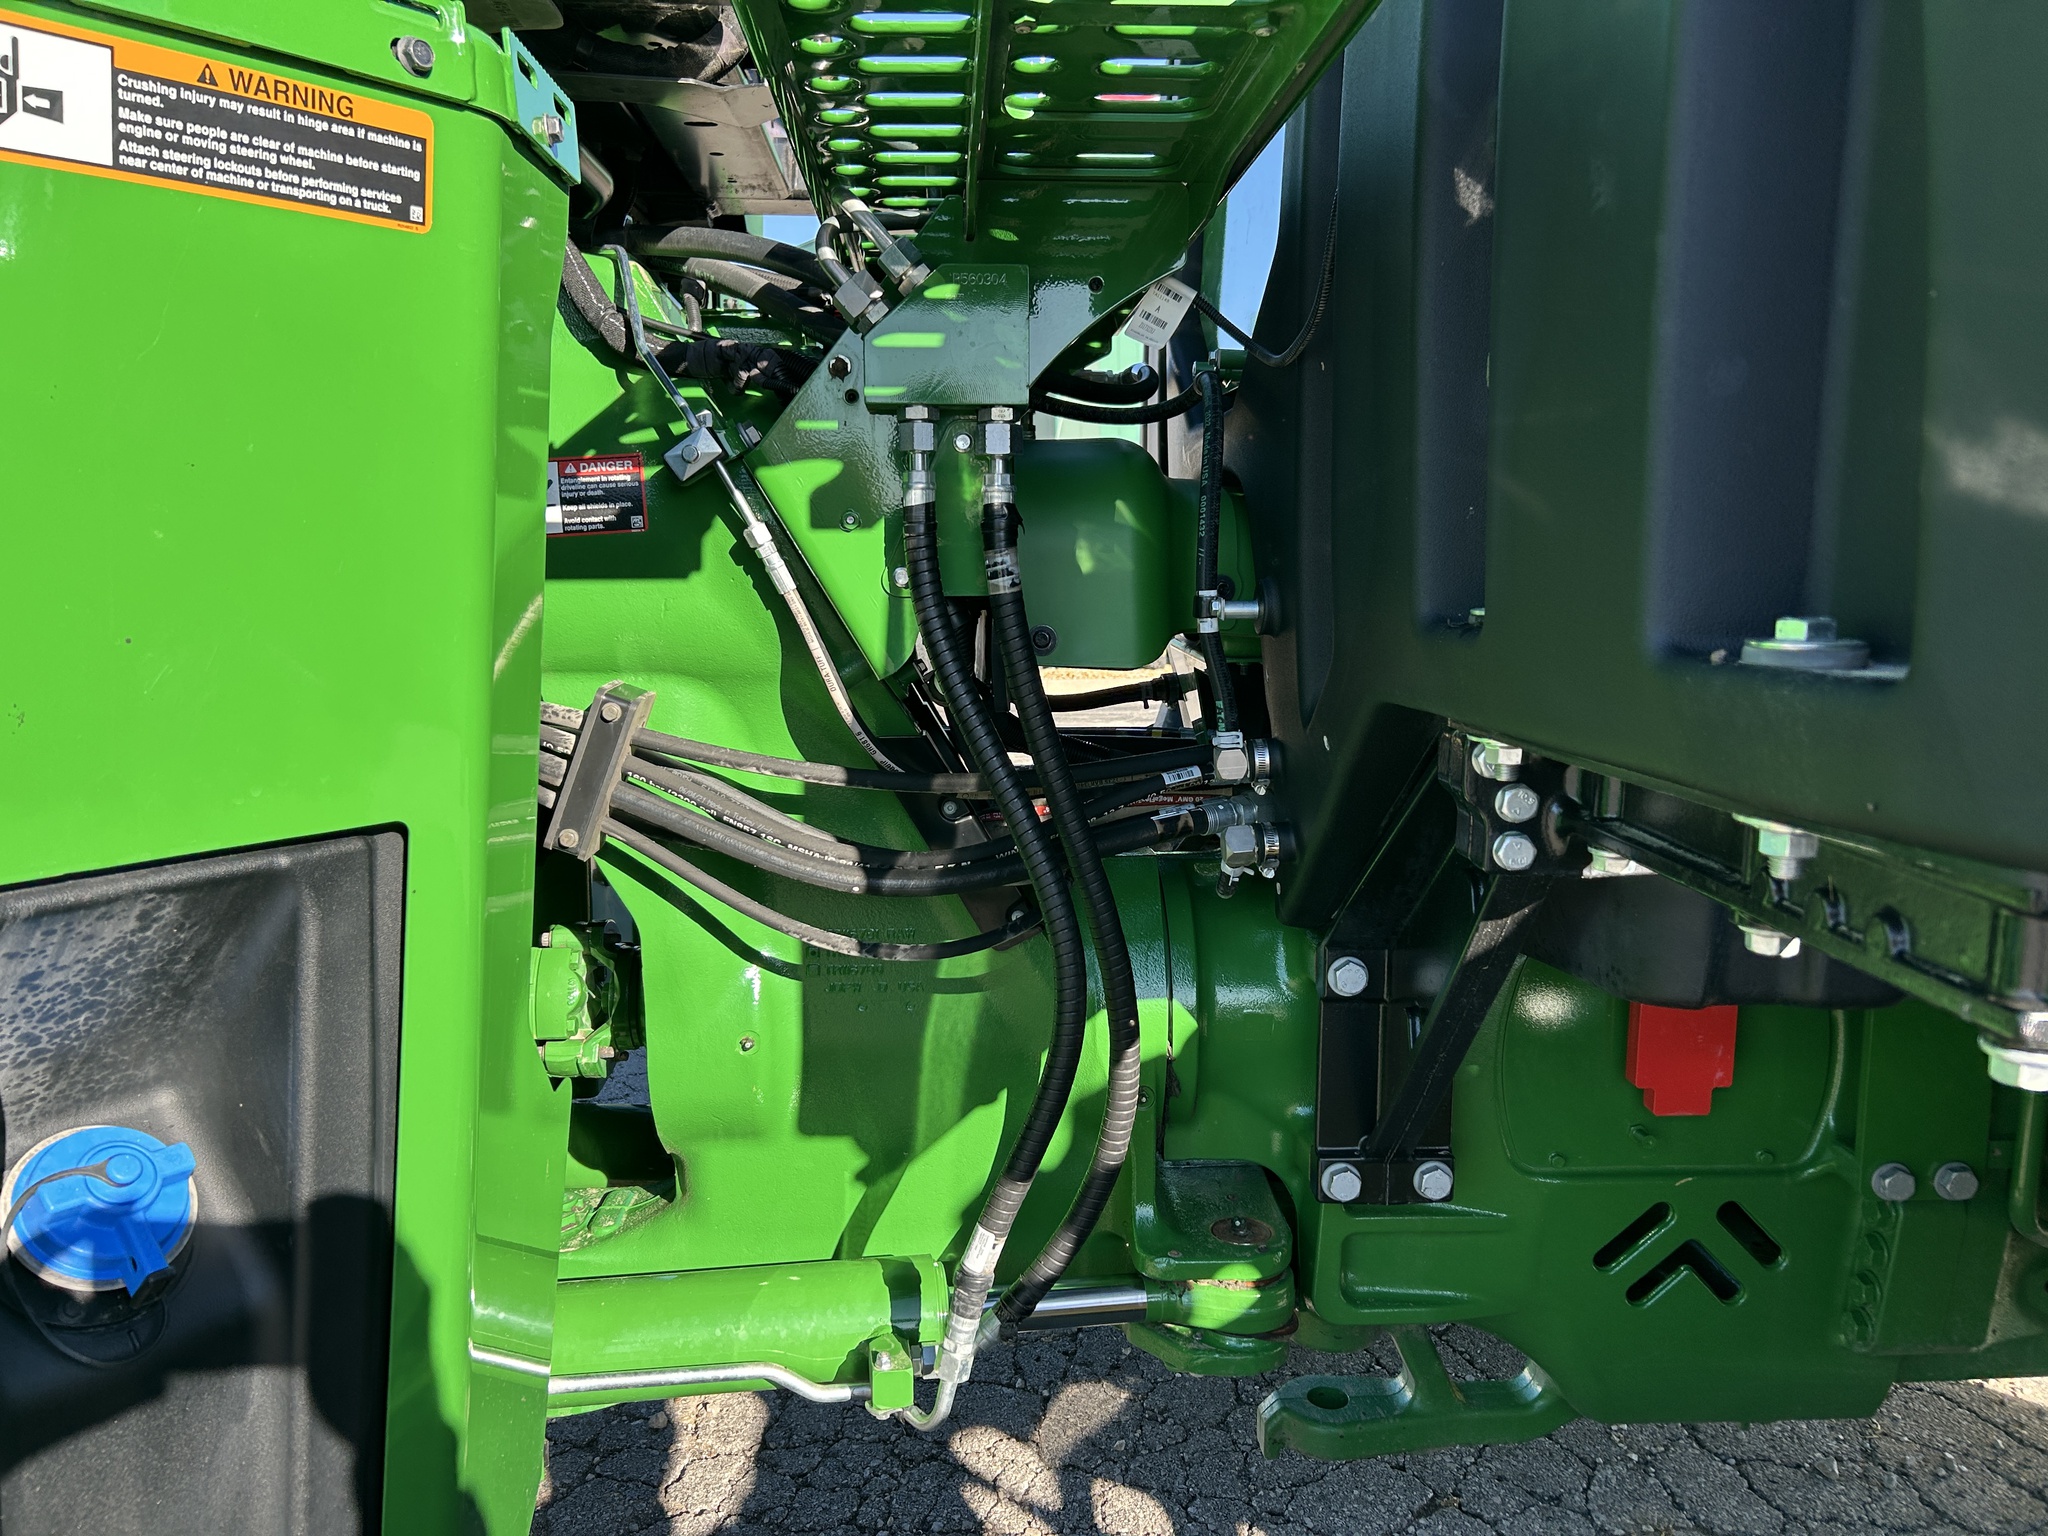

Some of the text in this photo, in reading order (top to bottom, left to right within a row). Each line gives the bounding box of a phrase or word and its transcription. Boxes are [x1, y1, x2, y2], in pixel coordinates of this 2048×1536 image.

[117, 87, 165, 108] turned.
[228, 67, 354, 119] WARNING
[117, 73, 423, 153] Crushing injury may result in hinge area if machine is
[118, 106, 421, 183] Make sure people are clear of machine before starting
[118, 122, 316, 171] engine or moving steering wheel.
[118, 139, 403, 204] Attach steering lockouts before performing services
[119, 155, 392, 214] near center of machine or transporting on a truck.
[1203, 432, 1212, 455] Made
[579, 460, 633, 473] DANGER
[1200, 466, 1210, 487] USA
[561, 474, 601, 484] Entanglement
[608, 474, 631, 483] rotating
[561, 483, 586, 491] driveline
[617, 480, 639, 488] serious
[561, 491, 578, 499] injury
[562, 504, 578, 512] Keep
[587, 502, 609, 510] shields
[616, 501, 634, 510] place.
[564, 523, 606, 532] rotating parts.
[581, 515, 604, 523] contact
[604, 514, 617, 522] with
[1215, 700, 1226, 732] EATON
